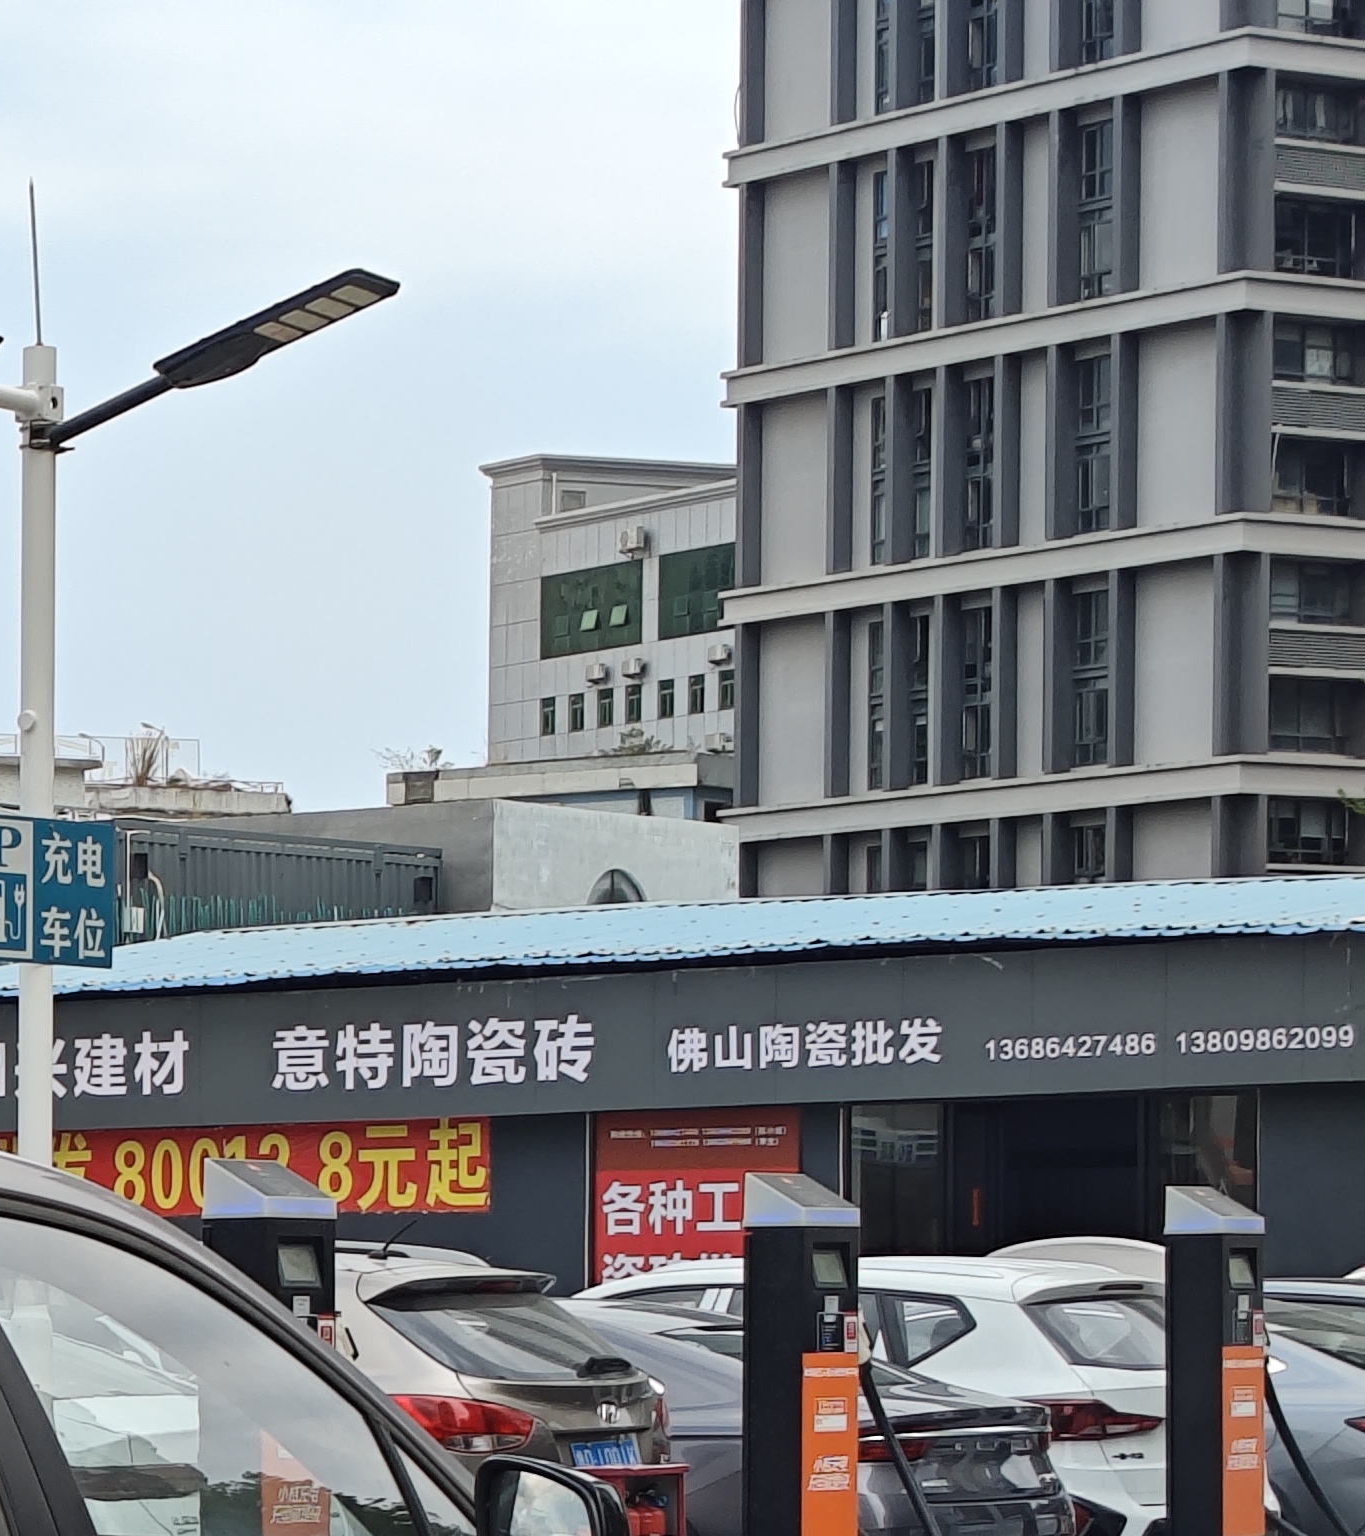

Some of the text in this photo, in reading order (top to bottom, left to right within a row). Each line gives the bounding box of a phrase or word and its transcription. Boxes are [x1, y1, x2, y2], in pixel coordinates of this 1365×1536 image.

[41, 831, 106, 888] 充电
[40, 906, 106, 960] 车位
[272, 1014, 596, 1092] 意特陶瓷砖
[667, 1017, 943, 1074] 佛山陶瓷批发
[984, 1033, 1157, 1061] 13686427486
[1175, 1024, 1355, 1055] 13809862099
[602, 1180, 742, 1235] 各种工
